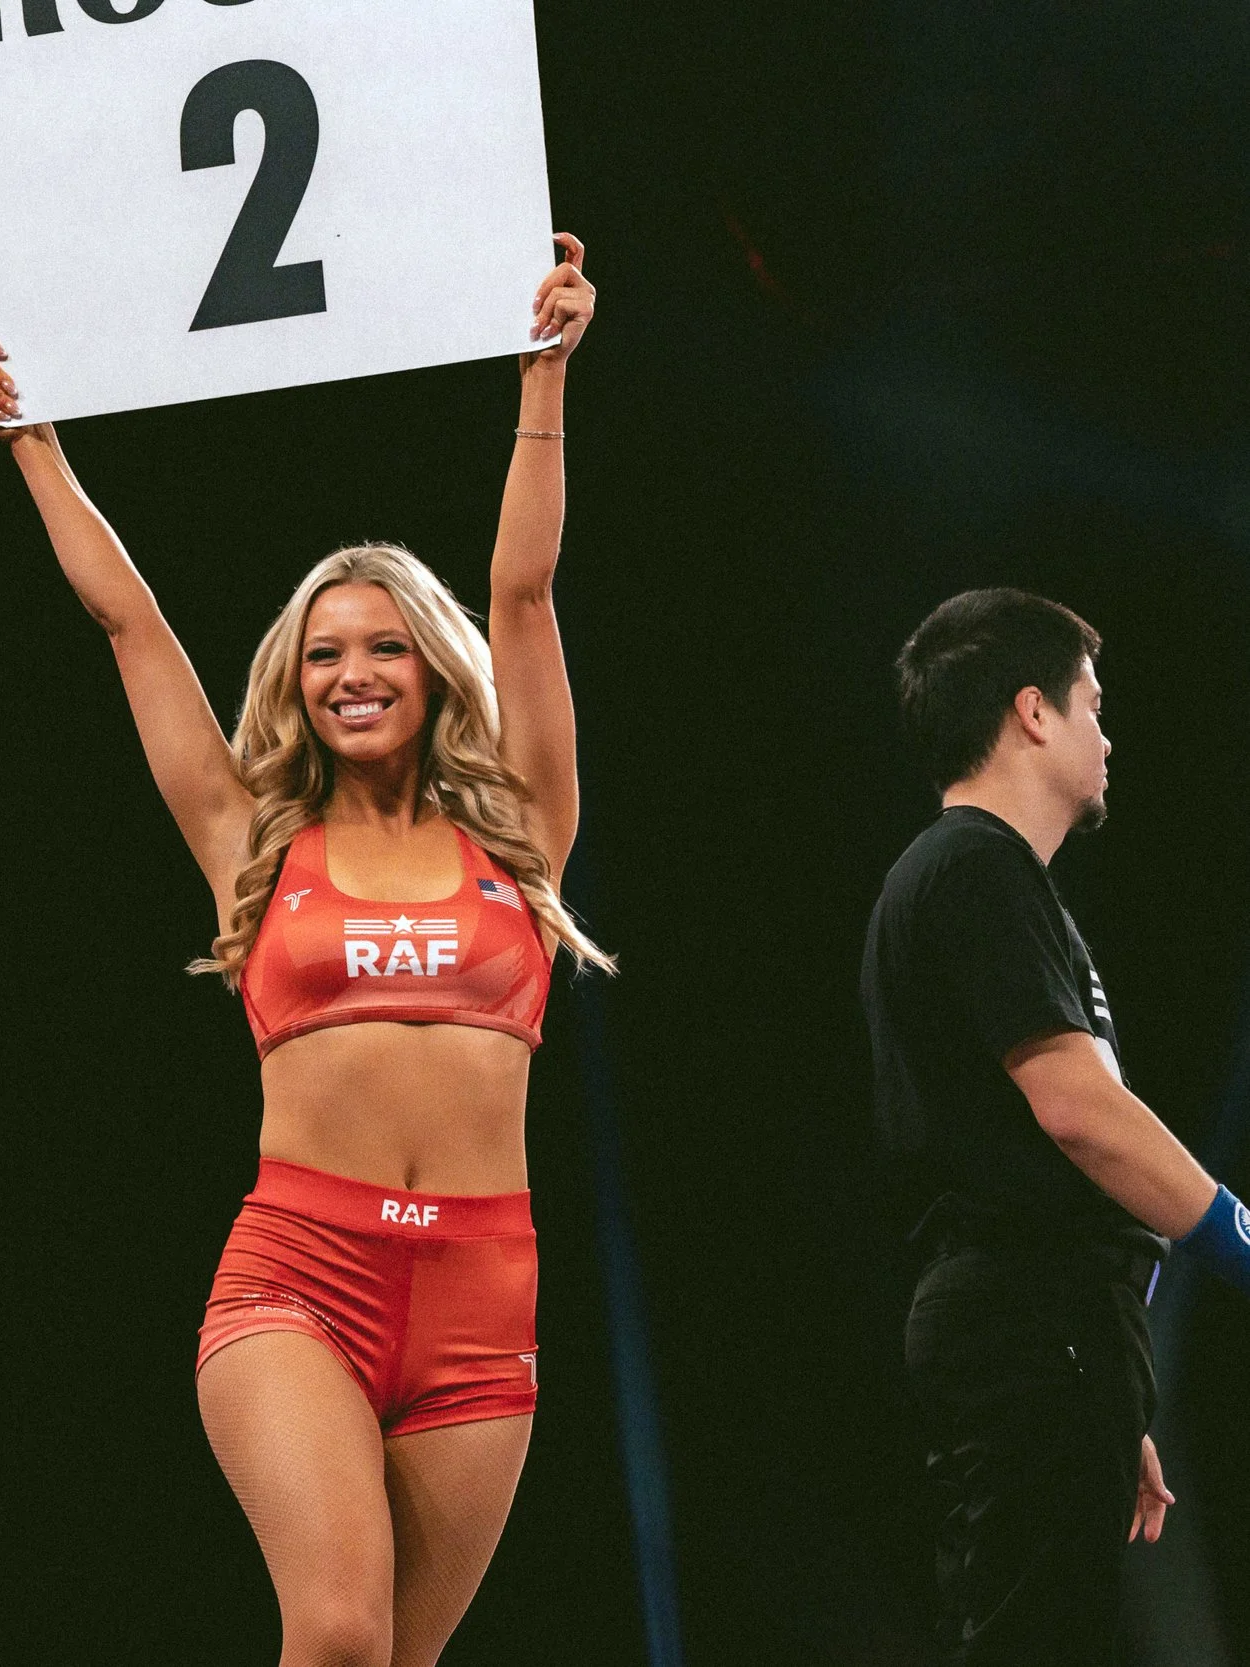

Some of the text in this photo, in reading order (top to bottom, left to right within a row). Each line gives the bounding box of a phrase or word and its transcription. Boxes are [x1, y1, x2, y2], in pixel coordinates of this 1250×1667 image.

[179, 59, 328, 333] 2
[344, 939, 459, 978] RAF
[380, 1199, 439, 1227] RAF
